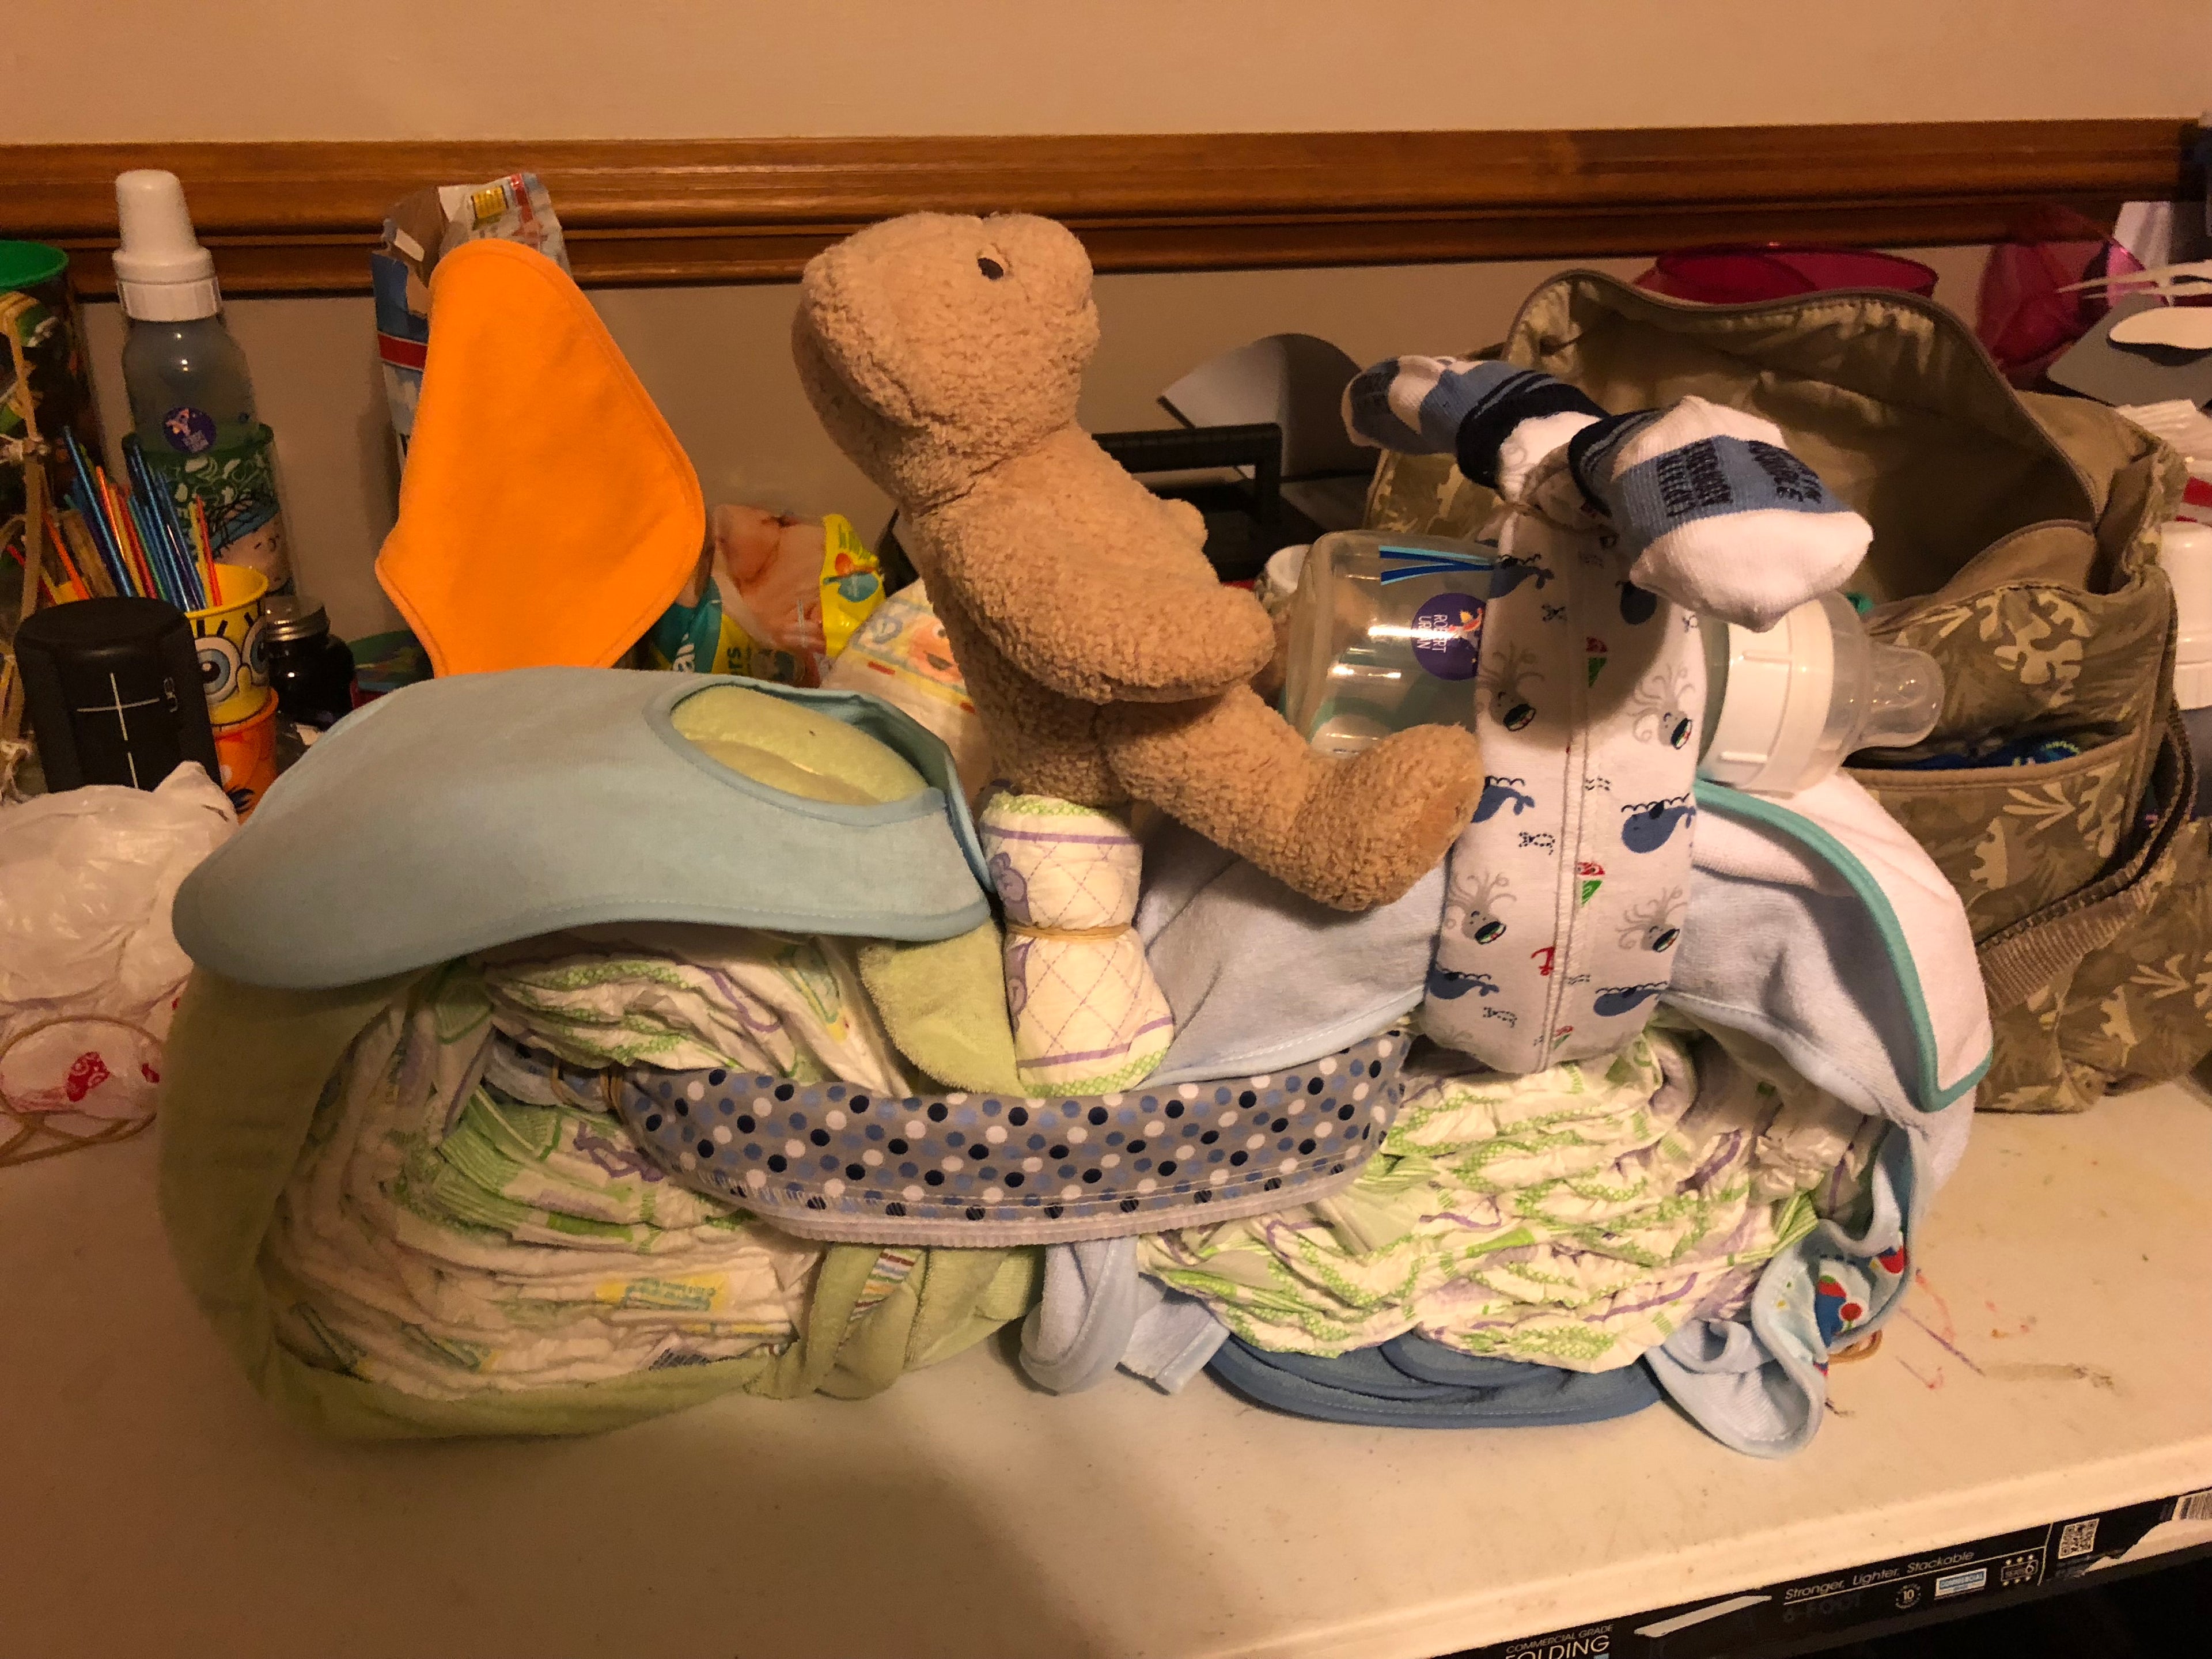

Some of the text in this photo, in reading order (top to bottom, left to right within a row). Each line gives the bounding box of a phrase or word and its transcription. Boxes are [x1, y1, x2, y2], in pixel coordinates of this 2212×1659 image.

[1416, 616, 1432, 649] URN
[1432, 614, 1448, 653] ROBRT
[1907, 1551, 1975, 1574] Stackable
[1903, 1589, 1915, 1600] 10
[1505, 1635, 1609, 1659] LDING
[1506, 1624, 1613, 1654] COMMERCIAL GRADE
